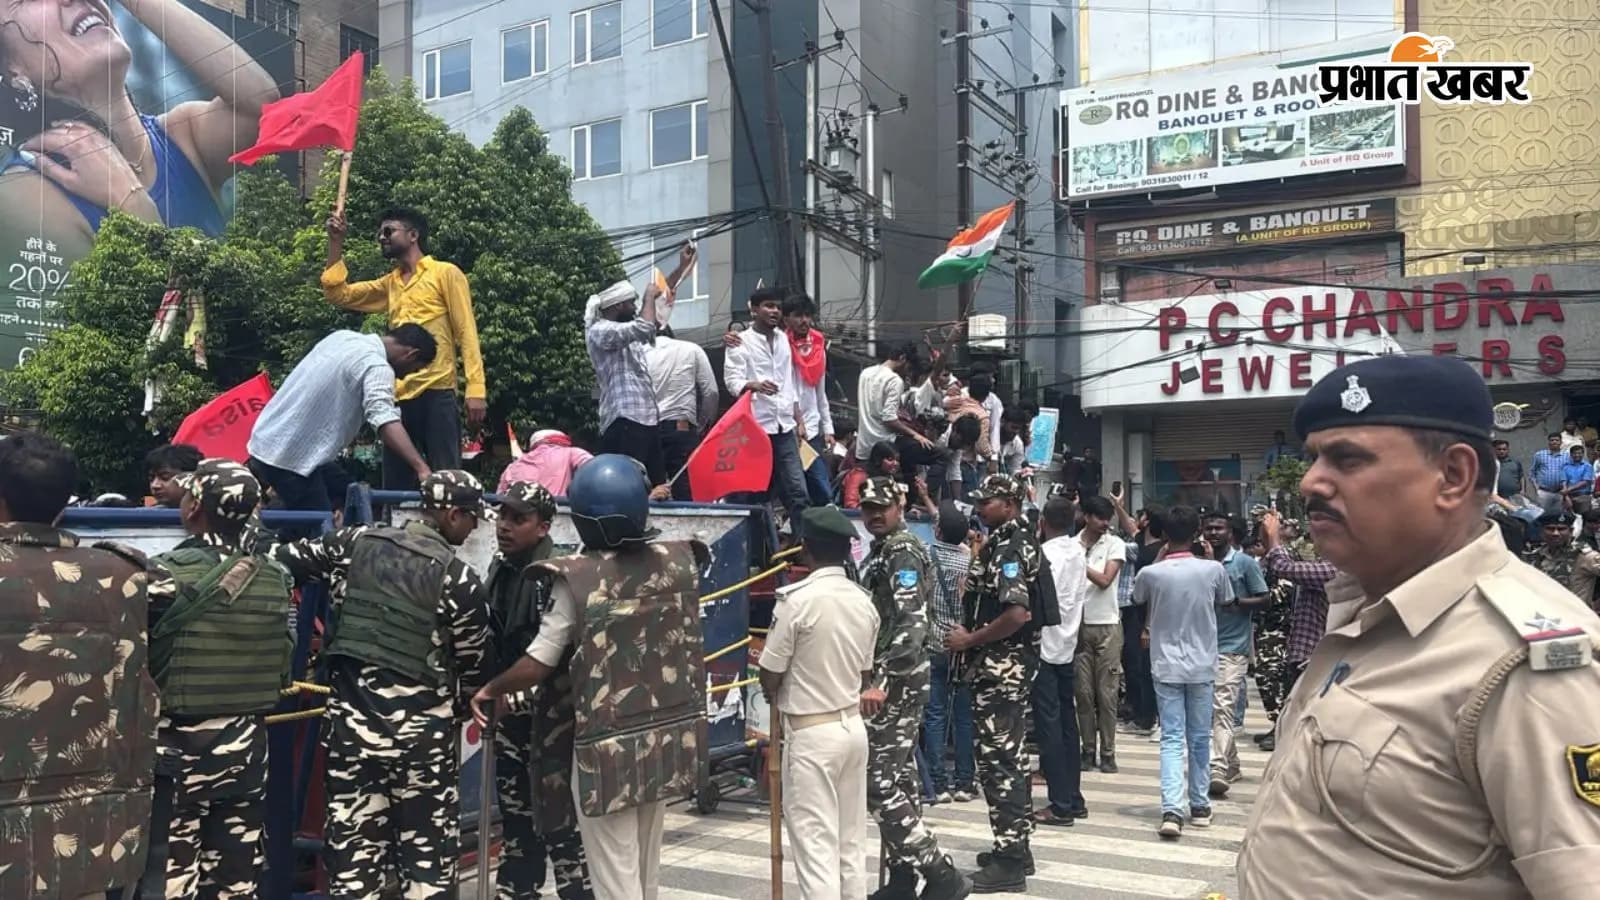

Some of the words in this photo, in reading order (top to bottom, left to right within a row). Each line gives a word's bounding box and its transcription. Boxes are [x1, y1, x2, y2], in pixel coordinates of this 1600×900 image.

[1116, 98, 1150, 121] RQ
[1157, 88, 1217, 115] DINE
[1225, 84, 1243, 105] &
[1158, 108, 1248, 131] BANQUET
[1254, 106, 1267, 118] &
[1300, 160, 1308, 168] A
[1309, 157, 1330, 167] Unit
[1333, 155, 1343, 165] of
[1362, 151, 1395, 161] Group
[1075, 185, 1092, 194] Call
[1198, 171, 1209, 180] 12
[1158, 222, 1214, 241] DINE
[1222, 221, 1241, 235] &
[1250, 204, 1372, 232] BANQUET
[1236, 233, 1249, 244] (A
[1251, 230, 1281, 241] UNIT
[1283, 228, 1301, 237] OF
[1302, 226, 1321, 235] RQ
[1323, 221, 1372, 233] GROUP)
[45, 240, 57, 252] के
[49, 255, 64, 266] पर
[9, 263, 70, 297] 20%
[16, 295, 41, 309] तक
[1263, 273, 1565, 343] CHANDRA
[1161, 335, 1567, 396] JEWERS
